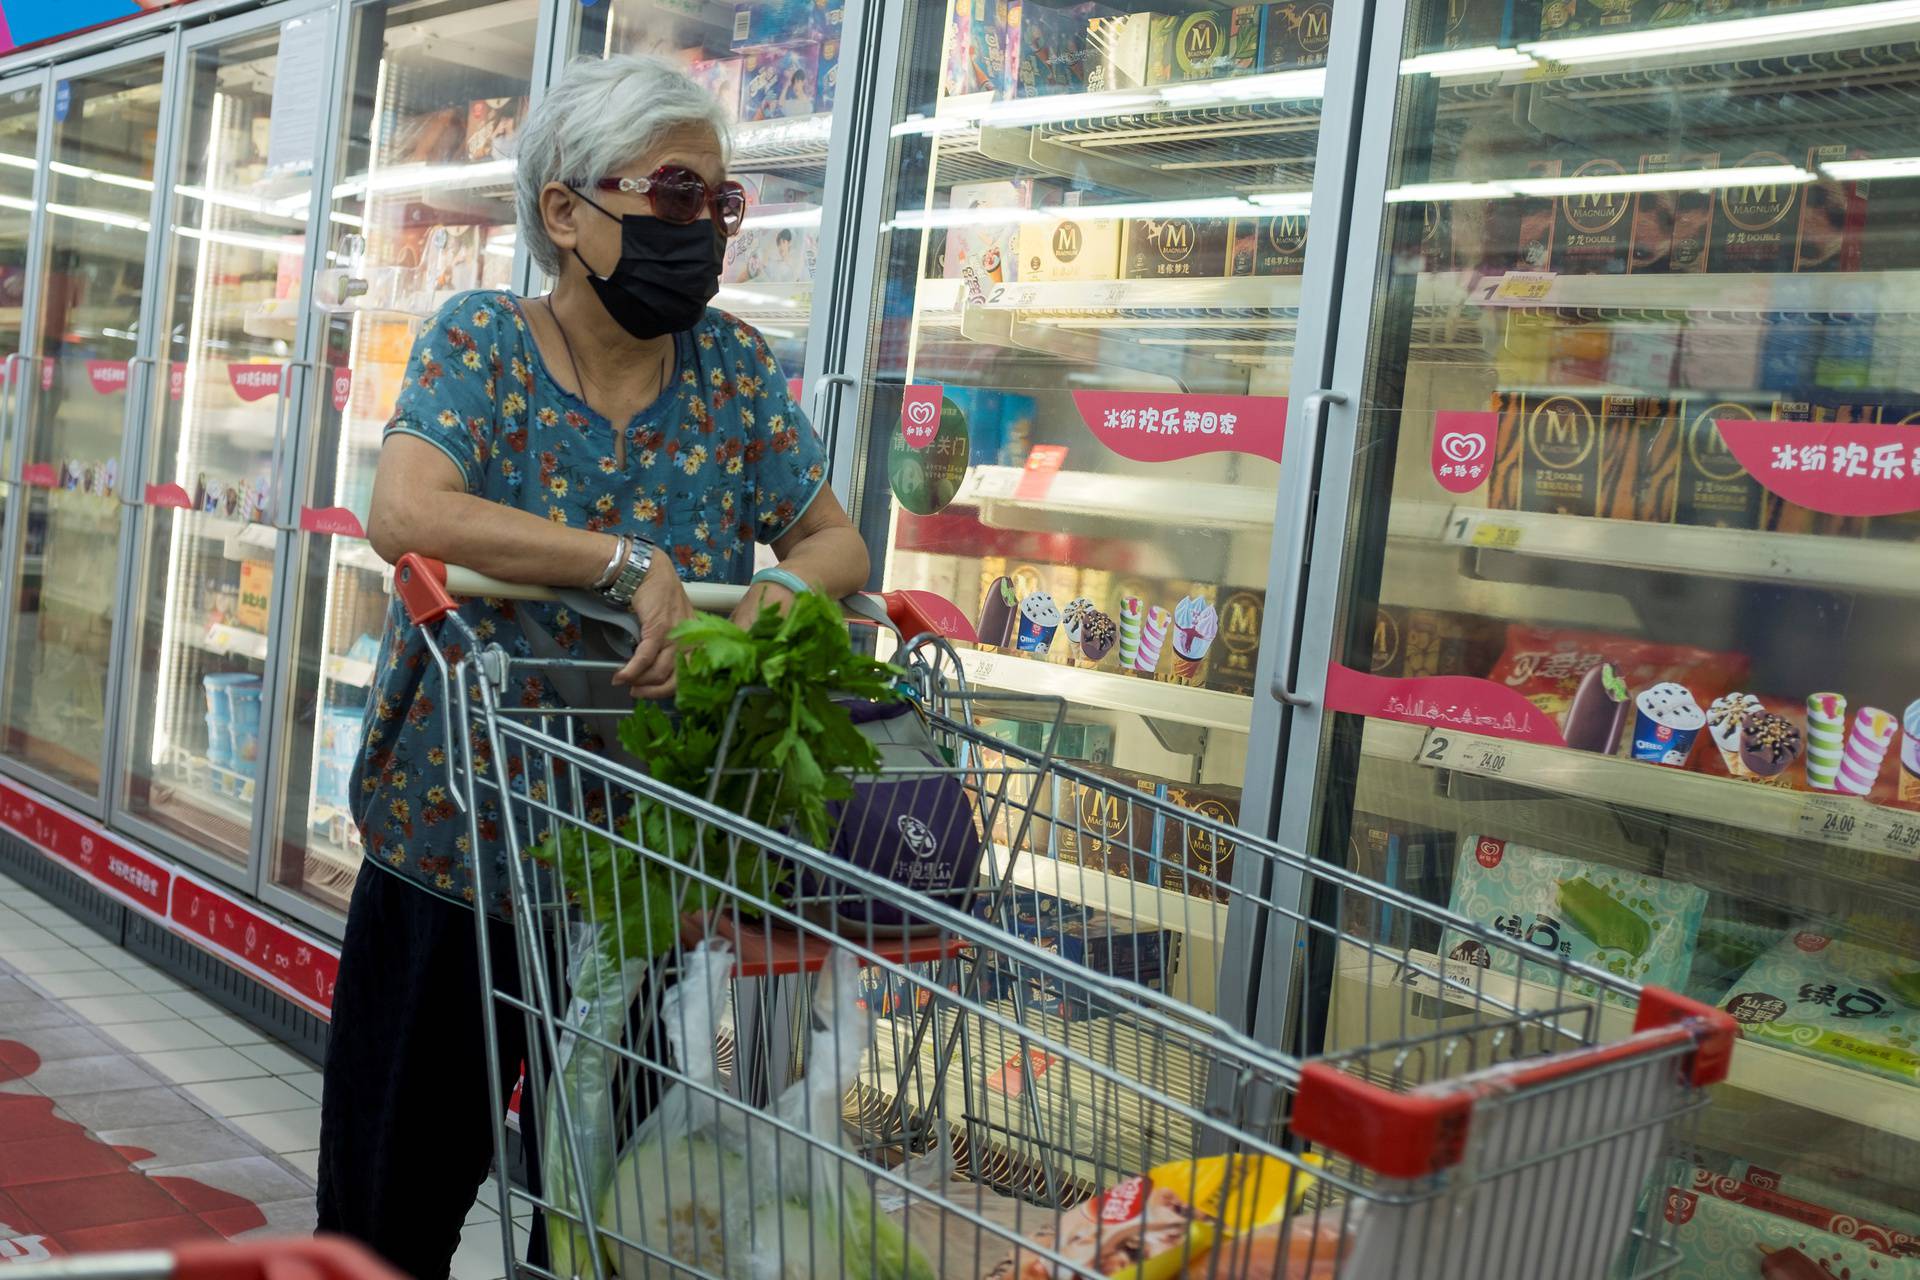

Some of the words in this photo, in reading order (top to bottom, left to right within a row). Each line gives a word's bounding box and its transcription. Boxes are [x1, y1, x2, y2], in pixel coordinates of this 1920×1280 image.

[1306, 12, 1328, 36] M
[1191, 28, 1211, 51] M
[1573, 207, 1615, 218] MAGNUM
[1733, 205, 1781, 216] MAGNUM
[1059, 228, 1077, 250] M
[1166, 224, 1187, 247] M
[1586, 235, 1617, 244] DOUBLE
[1747, 232, 1781, 242] DOUBLE
[1157, 263, 1191, 275] 迷你梦龙
[988, 287, 1006, 304] 2
[1482, 283, 1500, 300] 1
[1103, 407, 1238, 435] 冰纷欢乐带回家
[1546, 408, 1578, 445] M
[1439, 463, 1482, 479] 和路雪
[1454, 517, 1471, 539] 1
[1426, 737, 1449, 760] 2
[1480, 753, 1506, 770] 24.00
[1091, 789, 1119, 822] M
[1823, 813, 1856, 832] 24.00
[1886, 823, 1920, 845] 20.30
